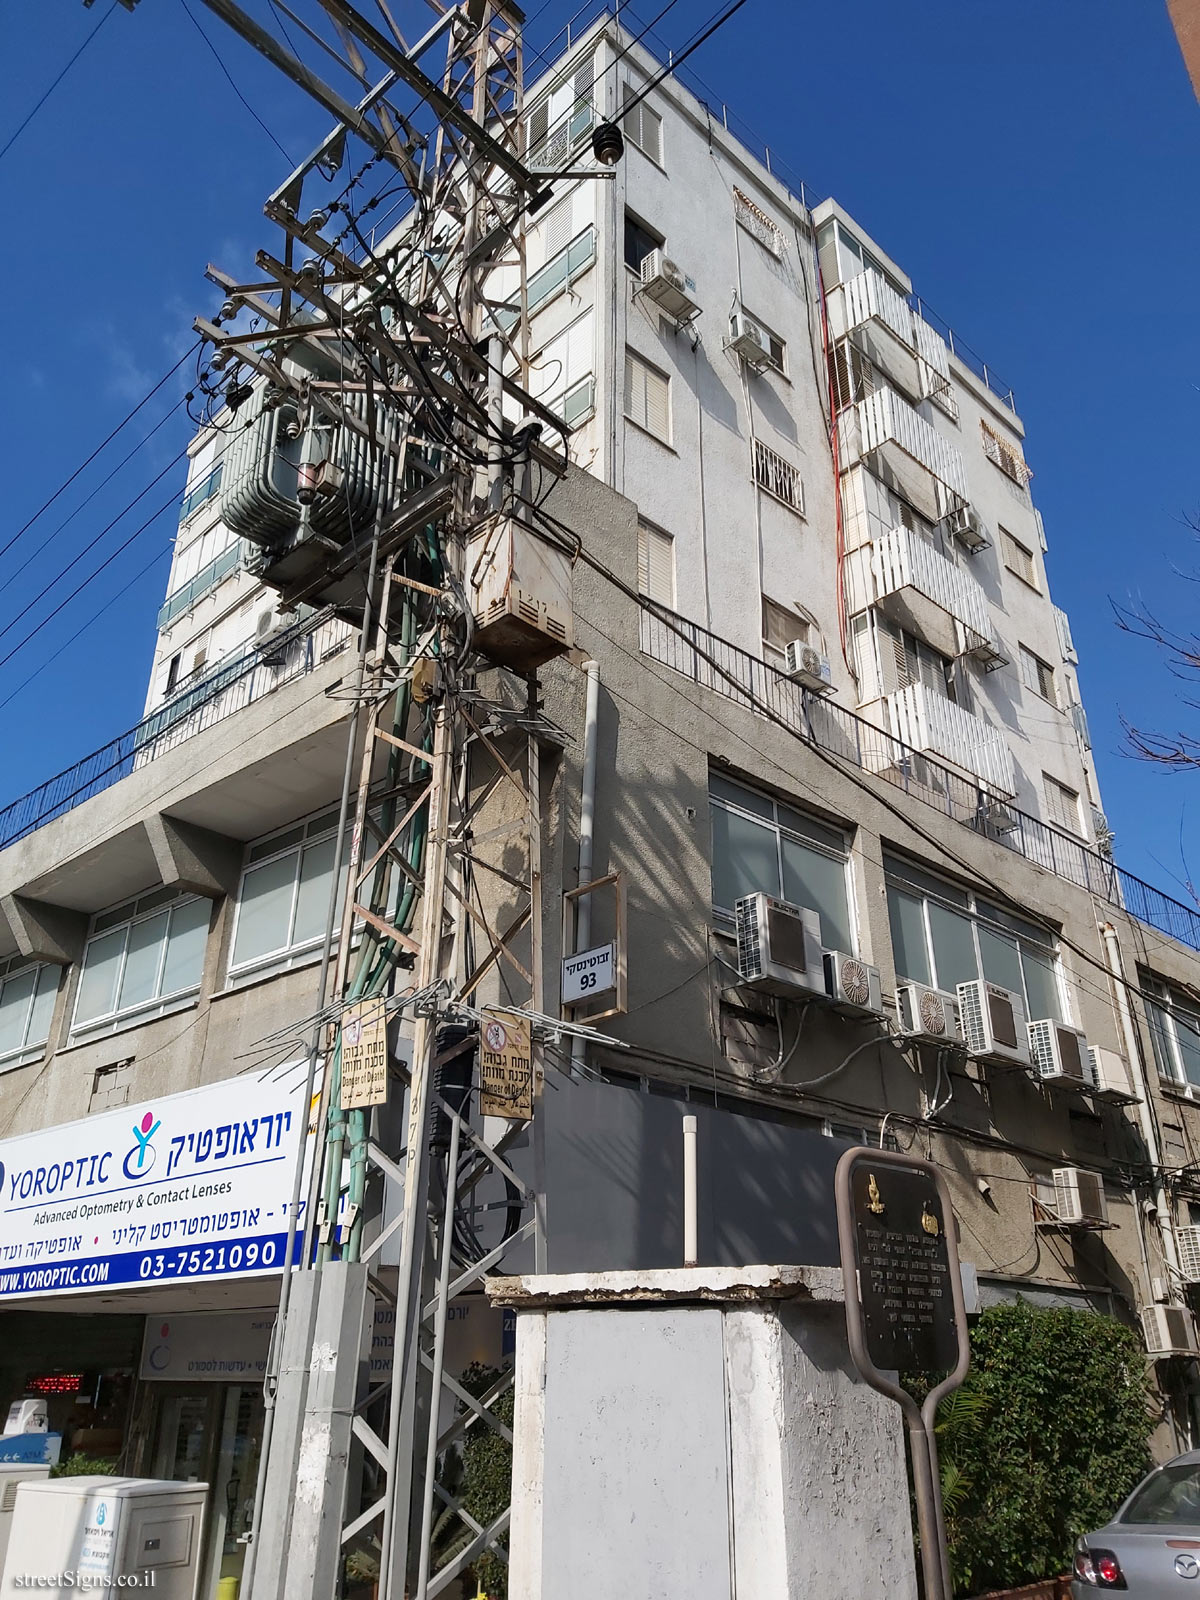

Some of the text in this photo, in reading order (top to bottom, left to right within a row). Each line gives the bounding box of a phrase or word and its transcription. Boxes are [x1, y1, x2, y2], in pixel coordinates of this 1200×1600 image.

[566, 951, 610, 976] זבוטינסקי
[580, 972, 597, 991] 93
[343, 1041, 384, 1060] מתח גבוה!
[483, 1051, 530, 1069] מתח גבוה!
[342, 1055, 384, 1073] סכנת מוות!
[482, 1065, 530, 1082] סכנת מוות!
[342, 1068, 385, 1088] Danger of Death!
[482, 1080, 504, 1094] Danger
[504, 1083, 511, 1095] of
[166, 1111, 292, 1177] יוראופטיק
[10, 1151, 113, 1201] YOROPTIC
[33, 1180, 232, 1226] Advanced Optometry & Contact Lenses
[112, 1223, 147, 1247] קליני
[150, 1207, 261, 1241] אופטומטריסט
[0, 1244, 23, 1260] ועד
[25, 1235, 83, 1260] אופטיקה
[139, 1241, 276, 1278] 03-7521090
